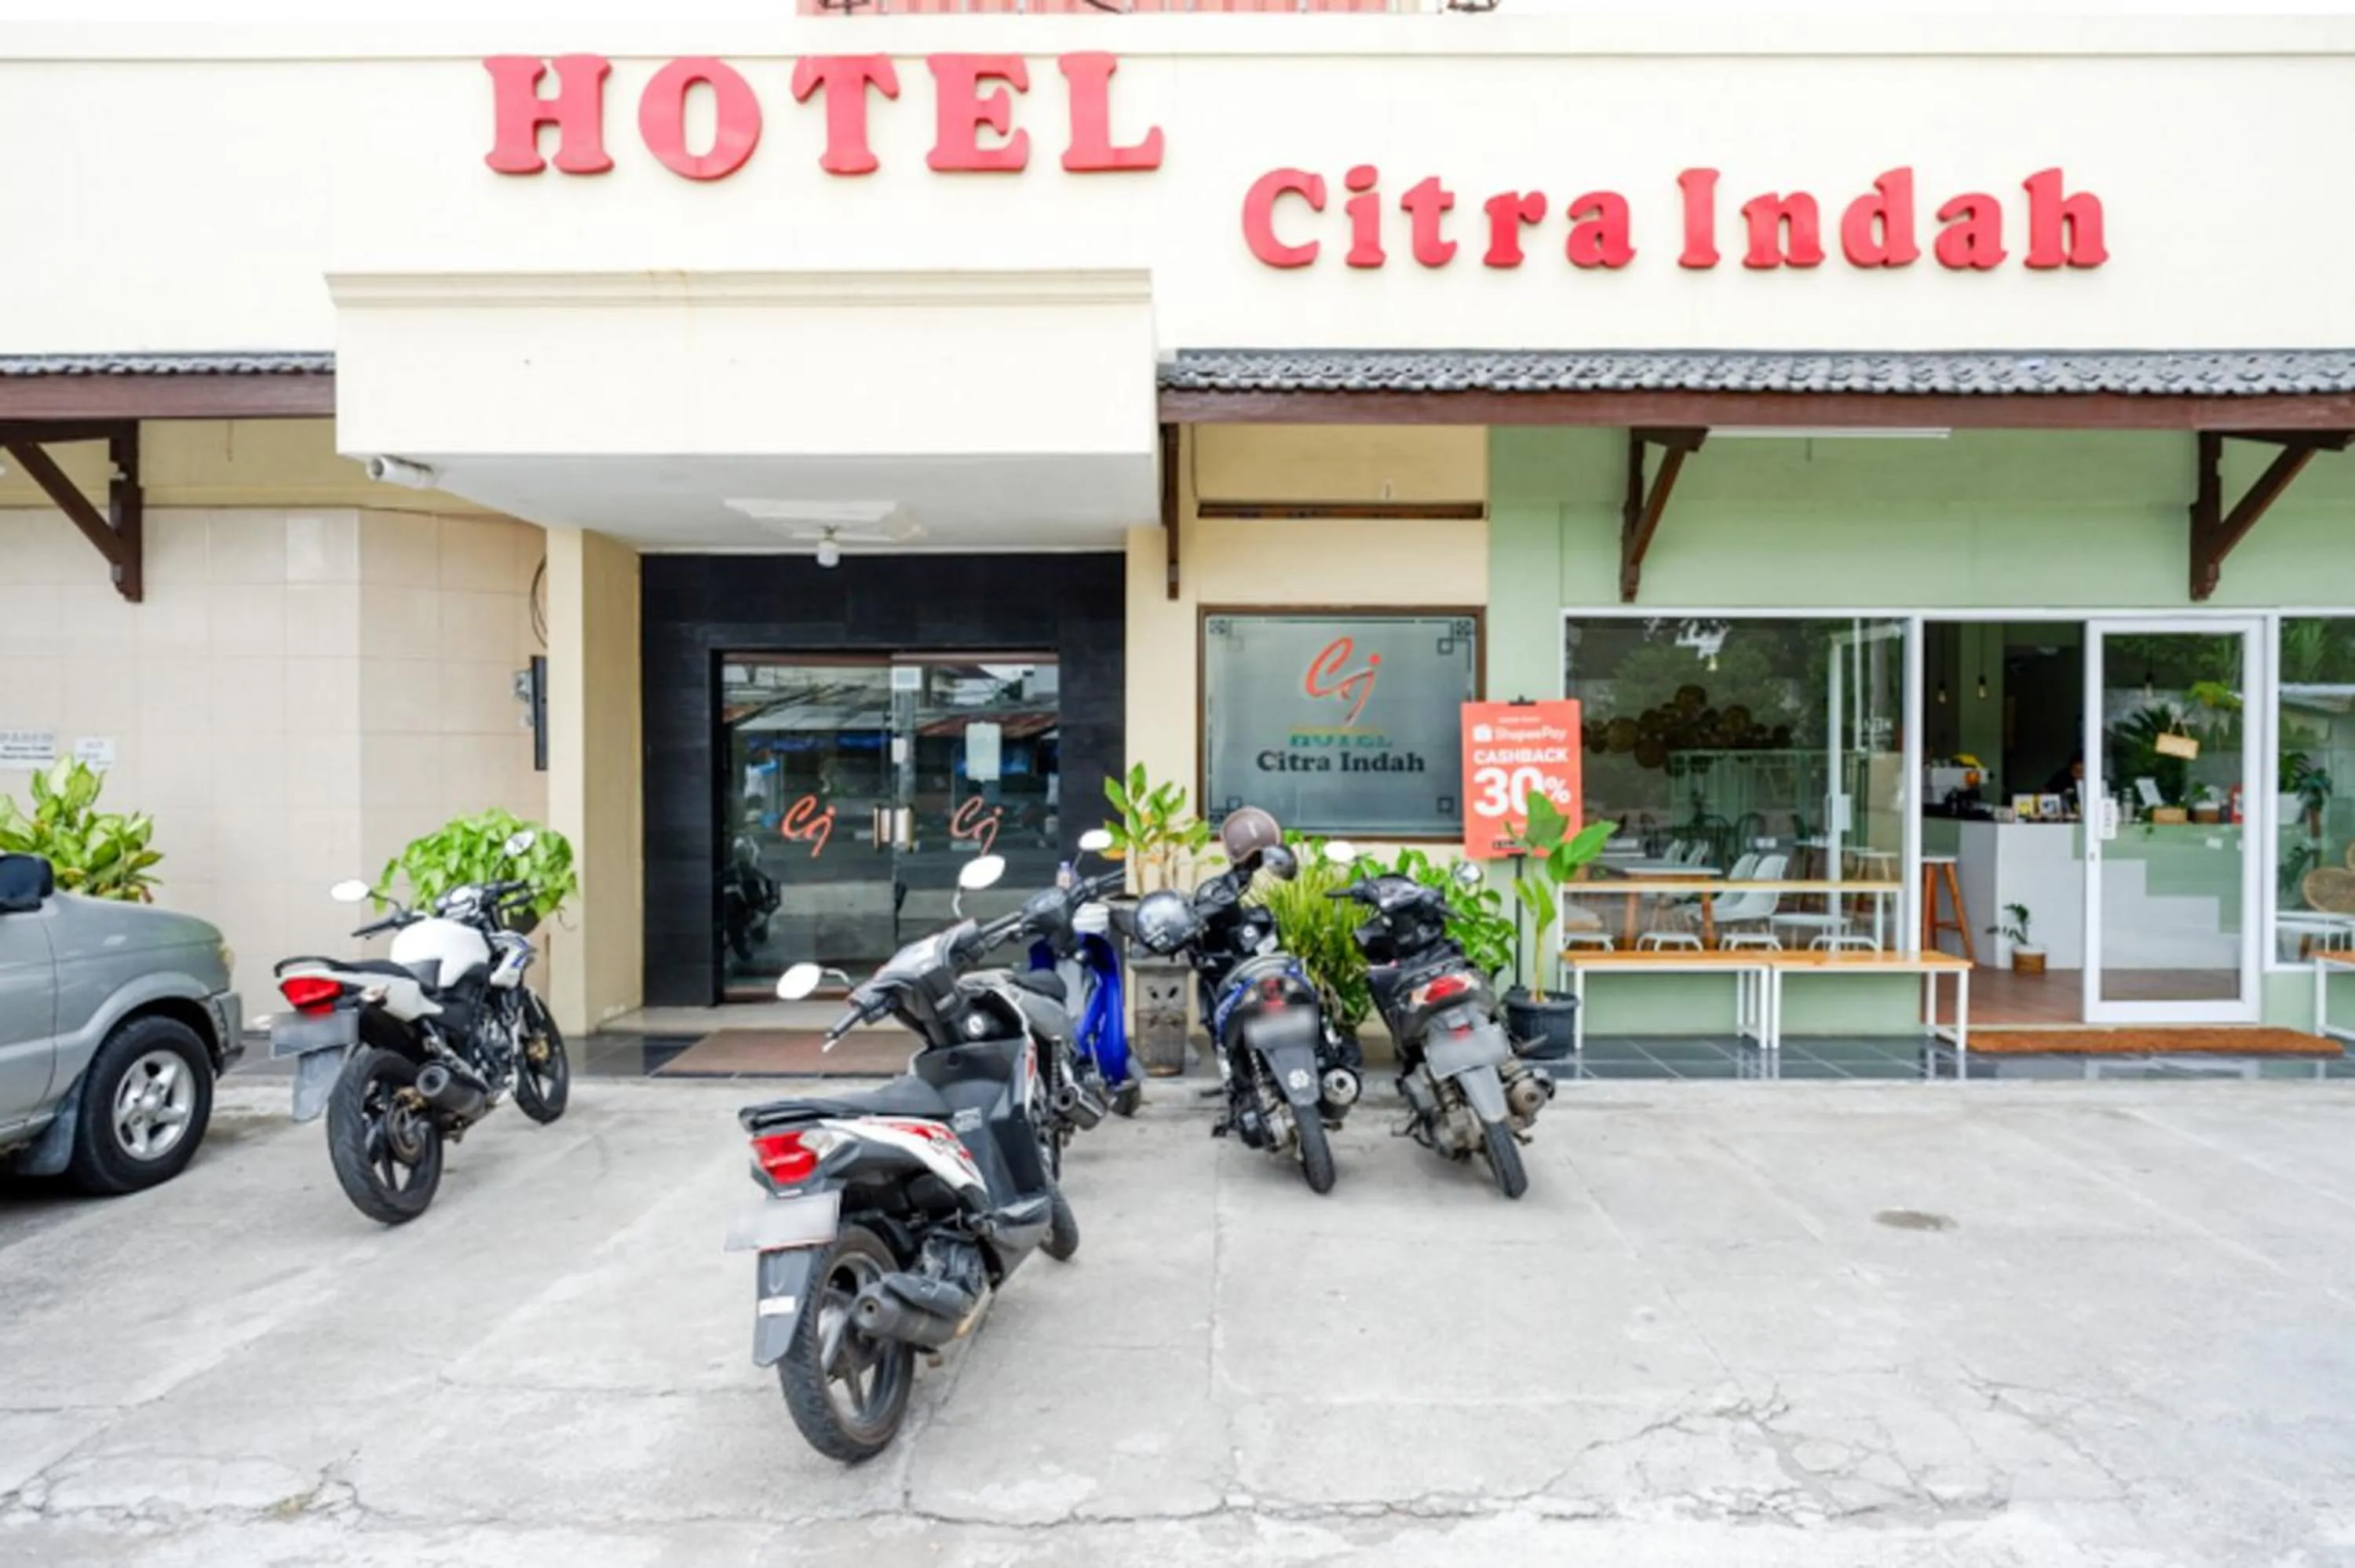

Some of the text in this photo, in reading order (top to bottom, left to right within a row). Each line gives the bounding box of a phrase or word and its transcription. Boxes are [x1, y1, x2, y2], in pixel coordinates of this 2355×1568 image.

[484, 51, 1163, 182] HOTEL
[1242, 164, 2110, 271] Citra Indah
[1256, 749, 1426, 772] Citra Indah
[1473, 749, 1568, 764] CASHBACK
